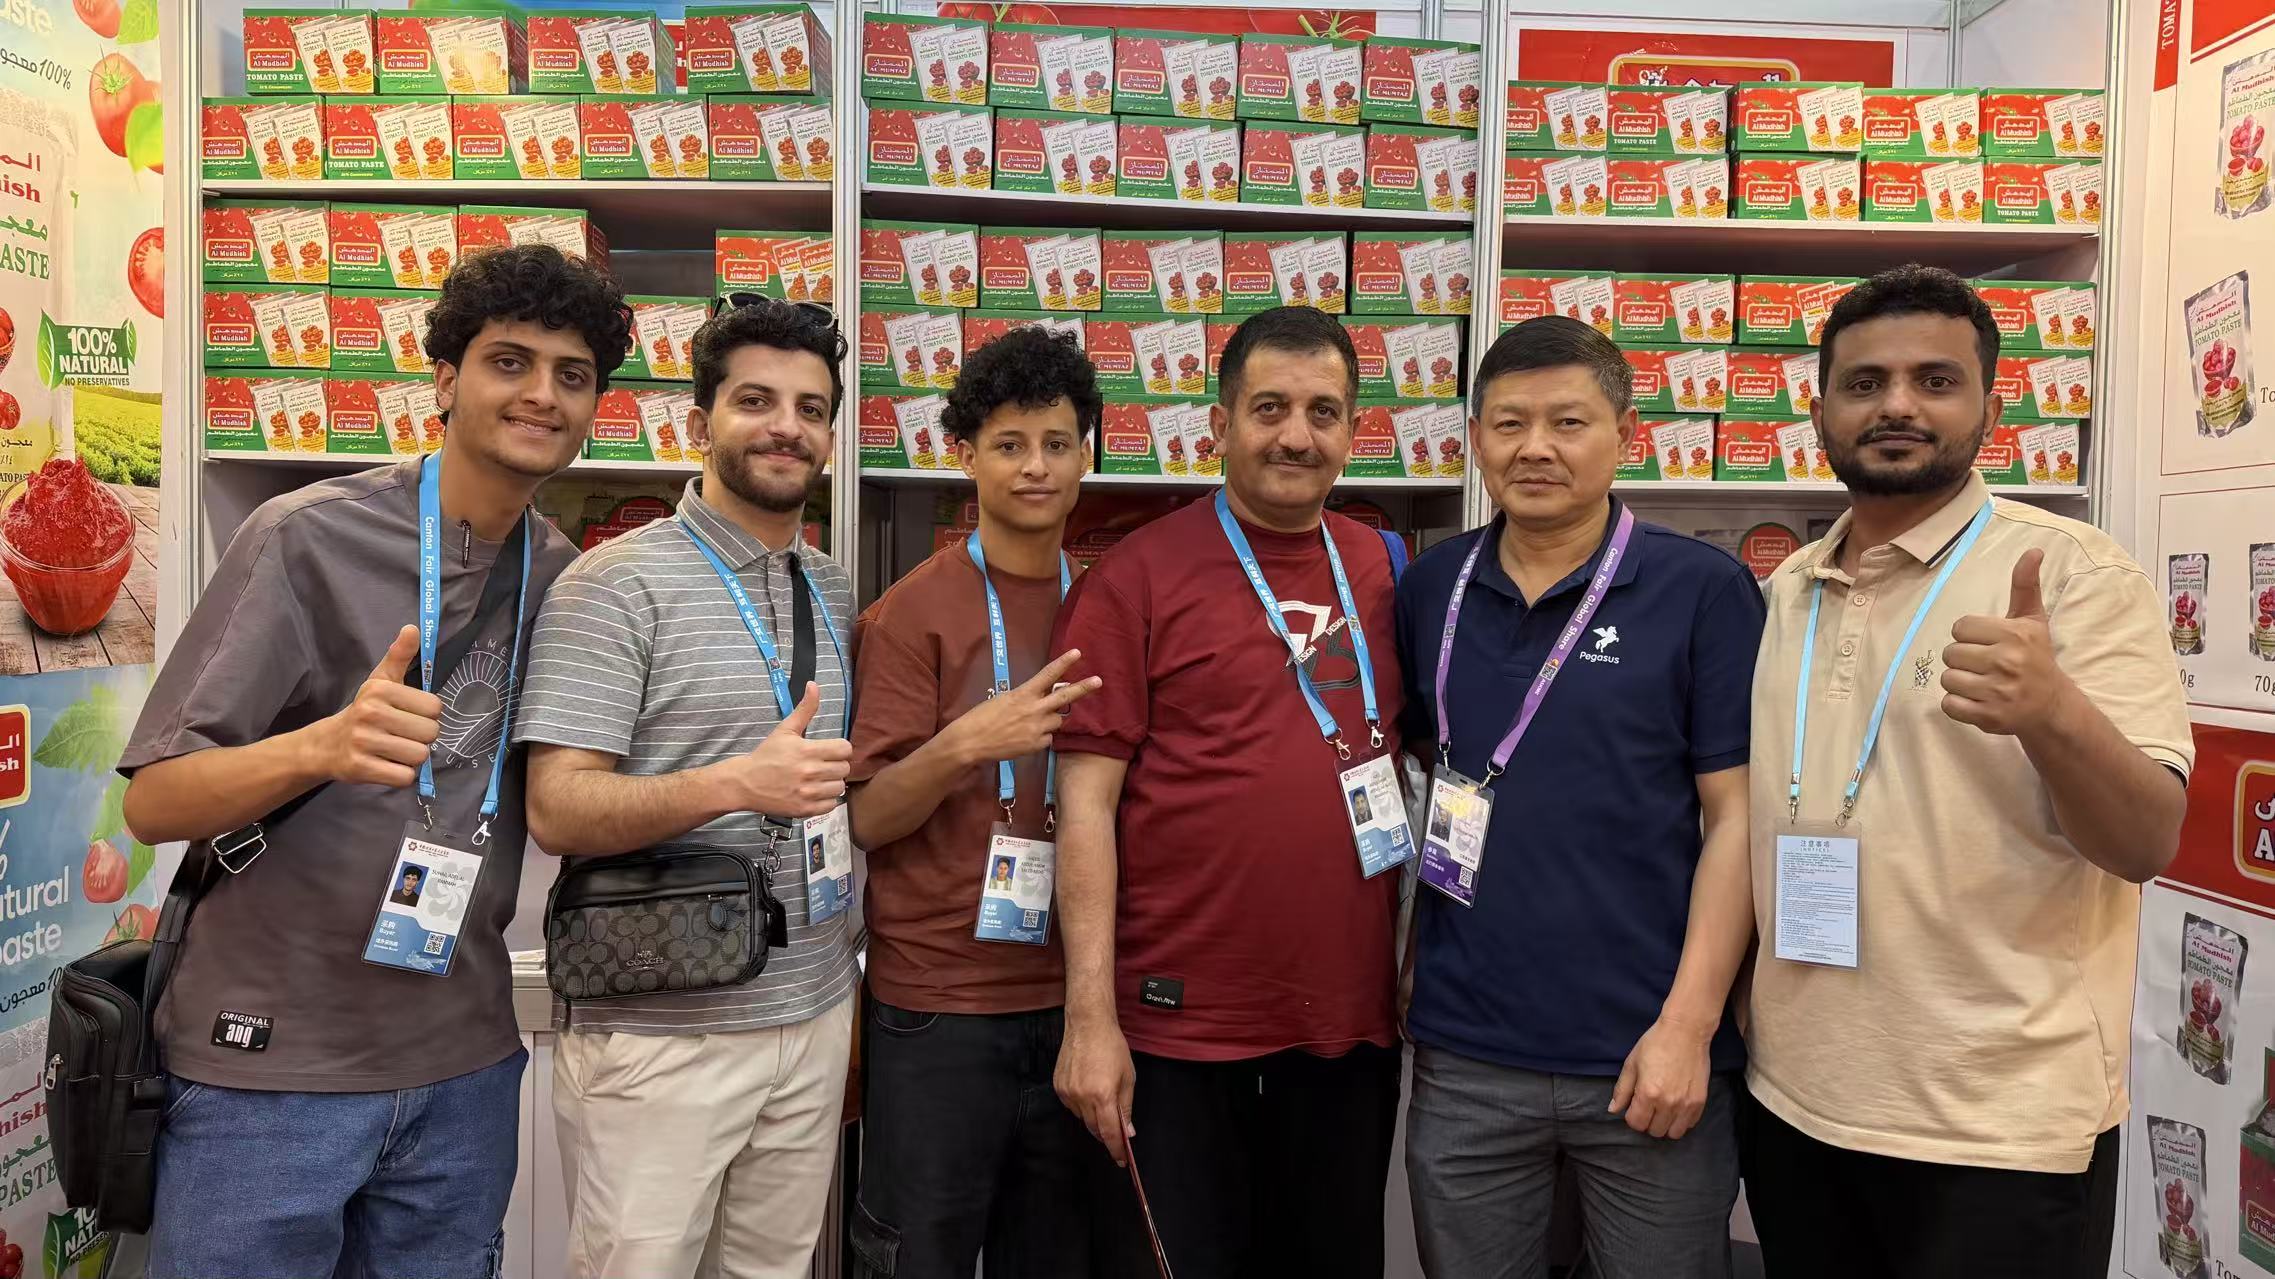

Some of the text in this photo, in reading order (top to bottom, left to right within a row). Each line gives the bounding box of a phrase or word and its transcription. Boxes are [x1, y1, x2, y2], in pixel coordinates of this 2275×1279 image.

[2162, 0, 2176, 50] TOMA
[0, 48, 72, 90] 100% معجو
[0, 174, 41, 203] ish
[67, 328, 117, 356] 100%
[59, 355, 128, 374] NATURAL
[64, 377, 130, 387] NO PRESERVATIVES
[425, 516, 434, 648] Canton Fair Global Share
[1558, 547, 1619, 650] Canton Fair Global Share
[1298, 645, 1318, 664] ESIGN
[1579, 651, 1620, 664] Pegasus
[2180, 668, 2195, 688] 0g
[220, 1012, 270, 1028] ORIGINAL
[65, 1221, 98, 1257] NAT
